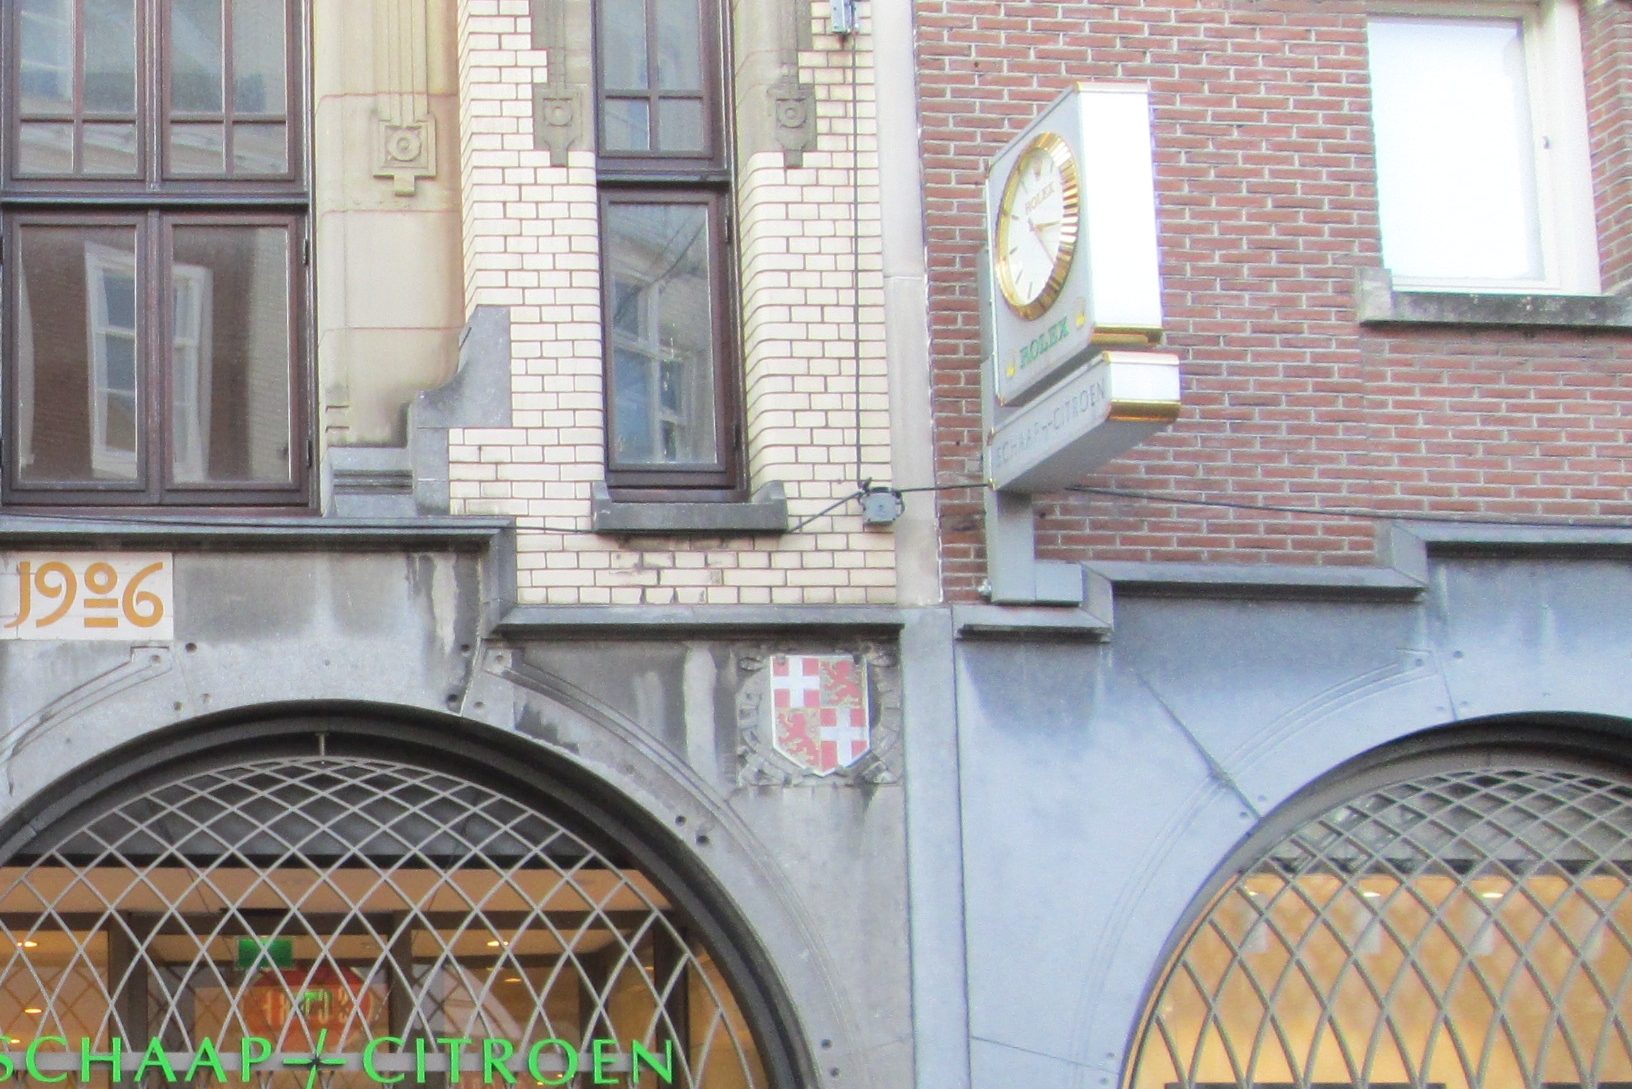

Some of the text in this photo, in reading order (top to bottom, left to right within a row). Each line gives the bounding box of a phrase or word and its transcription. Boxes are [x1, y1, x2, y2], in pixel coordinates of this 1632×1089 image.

[1020, 316, 1071, 369] ROLEX
[1054, 378, 1106, 430] CITROEN
[362, 1037, 673, 1086] CITROEN
